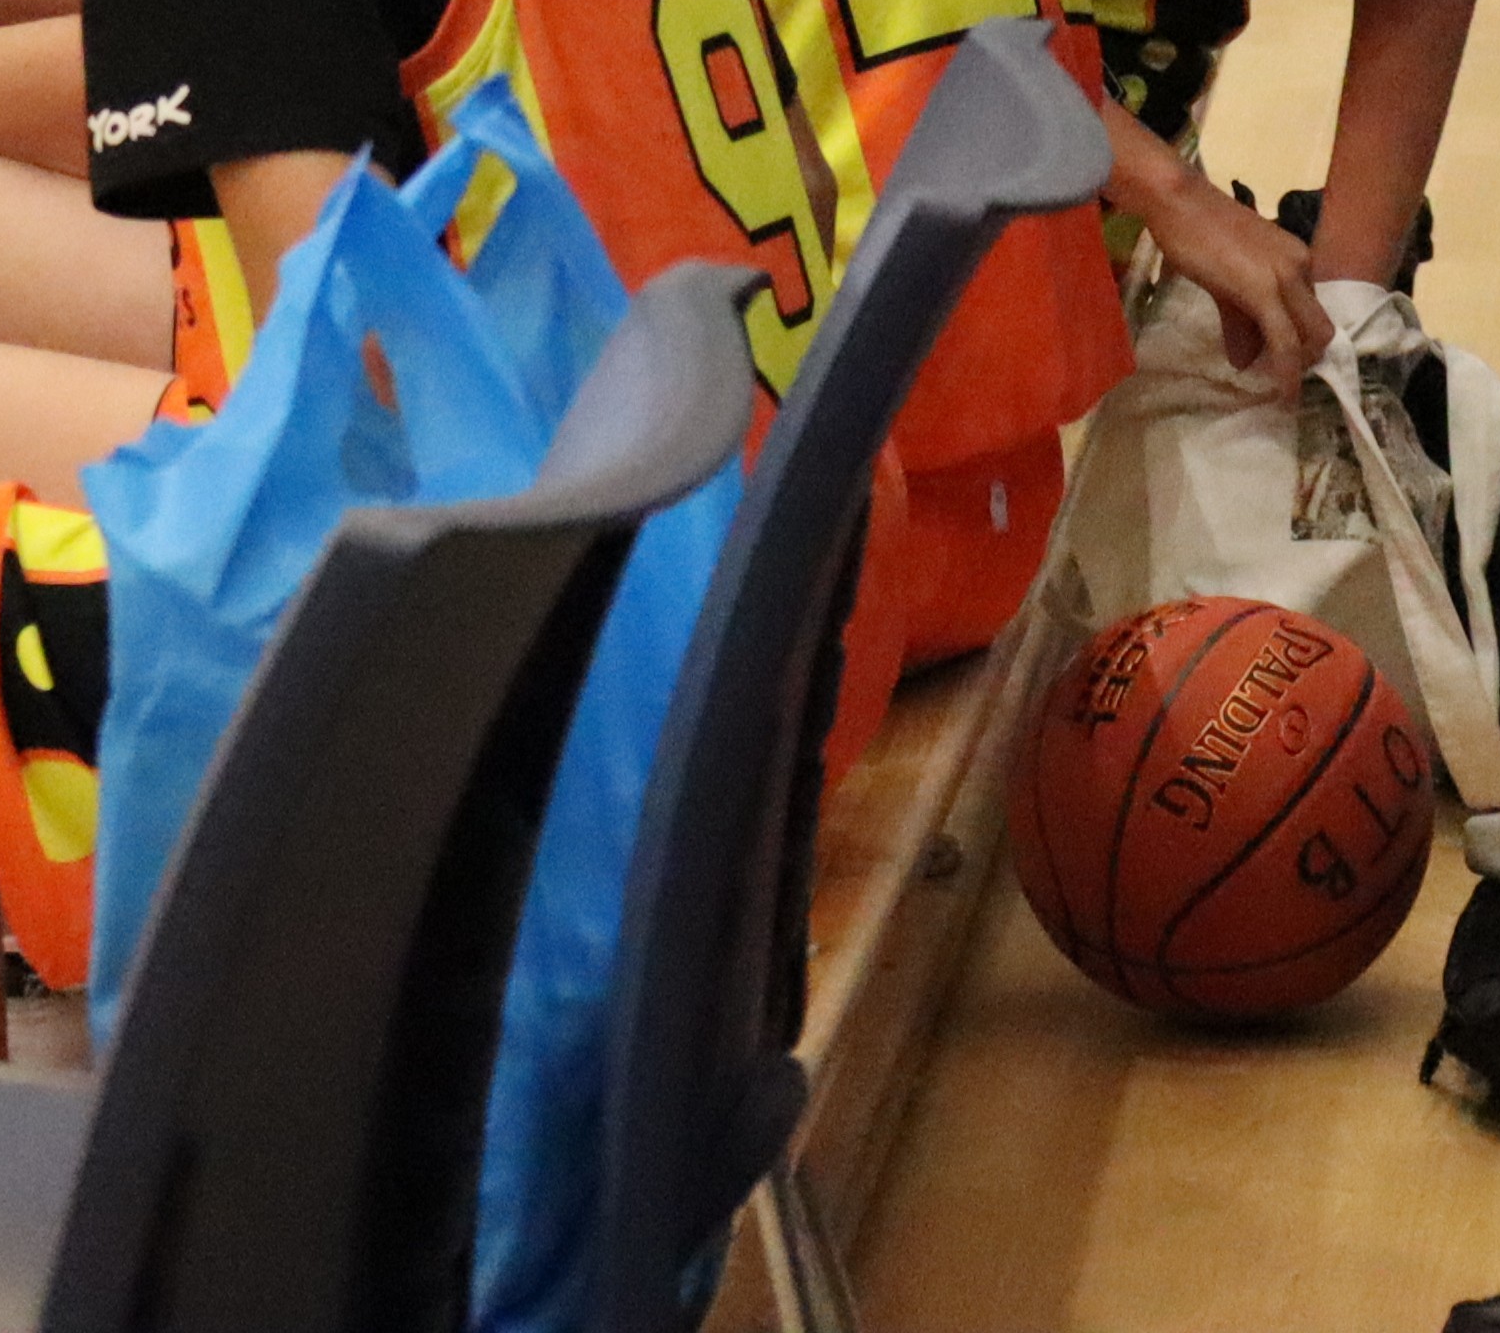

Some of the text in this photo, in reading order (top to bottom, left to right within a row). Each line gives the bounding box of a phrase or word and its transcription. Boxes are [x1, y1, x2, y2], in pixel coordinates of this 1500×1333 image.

[87, 83, 192, 153] YORK
[1149, 617, 1335, 833] SPALDING
[1297, 723, 1425, 902] OTB
